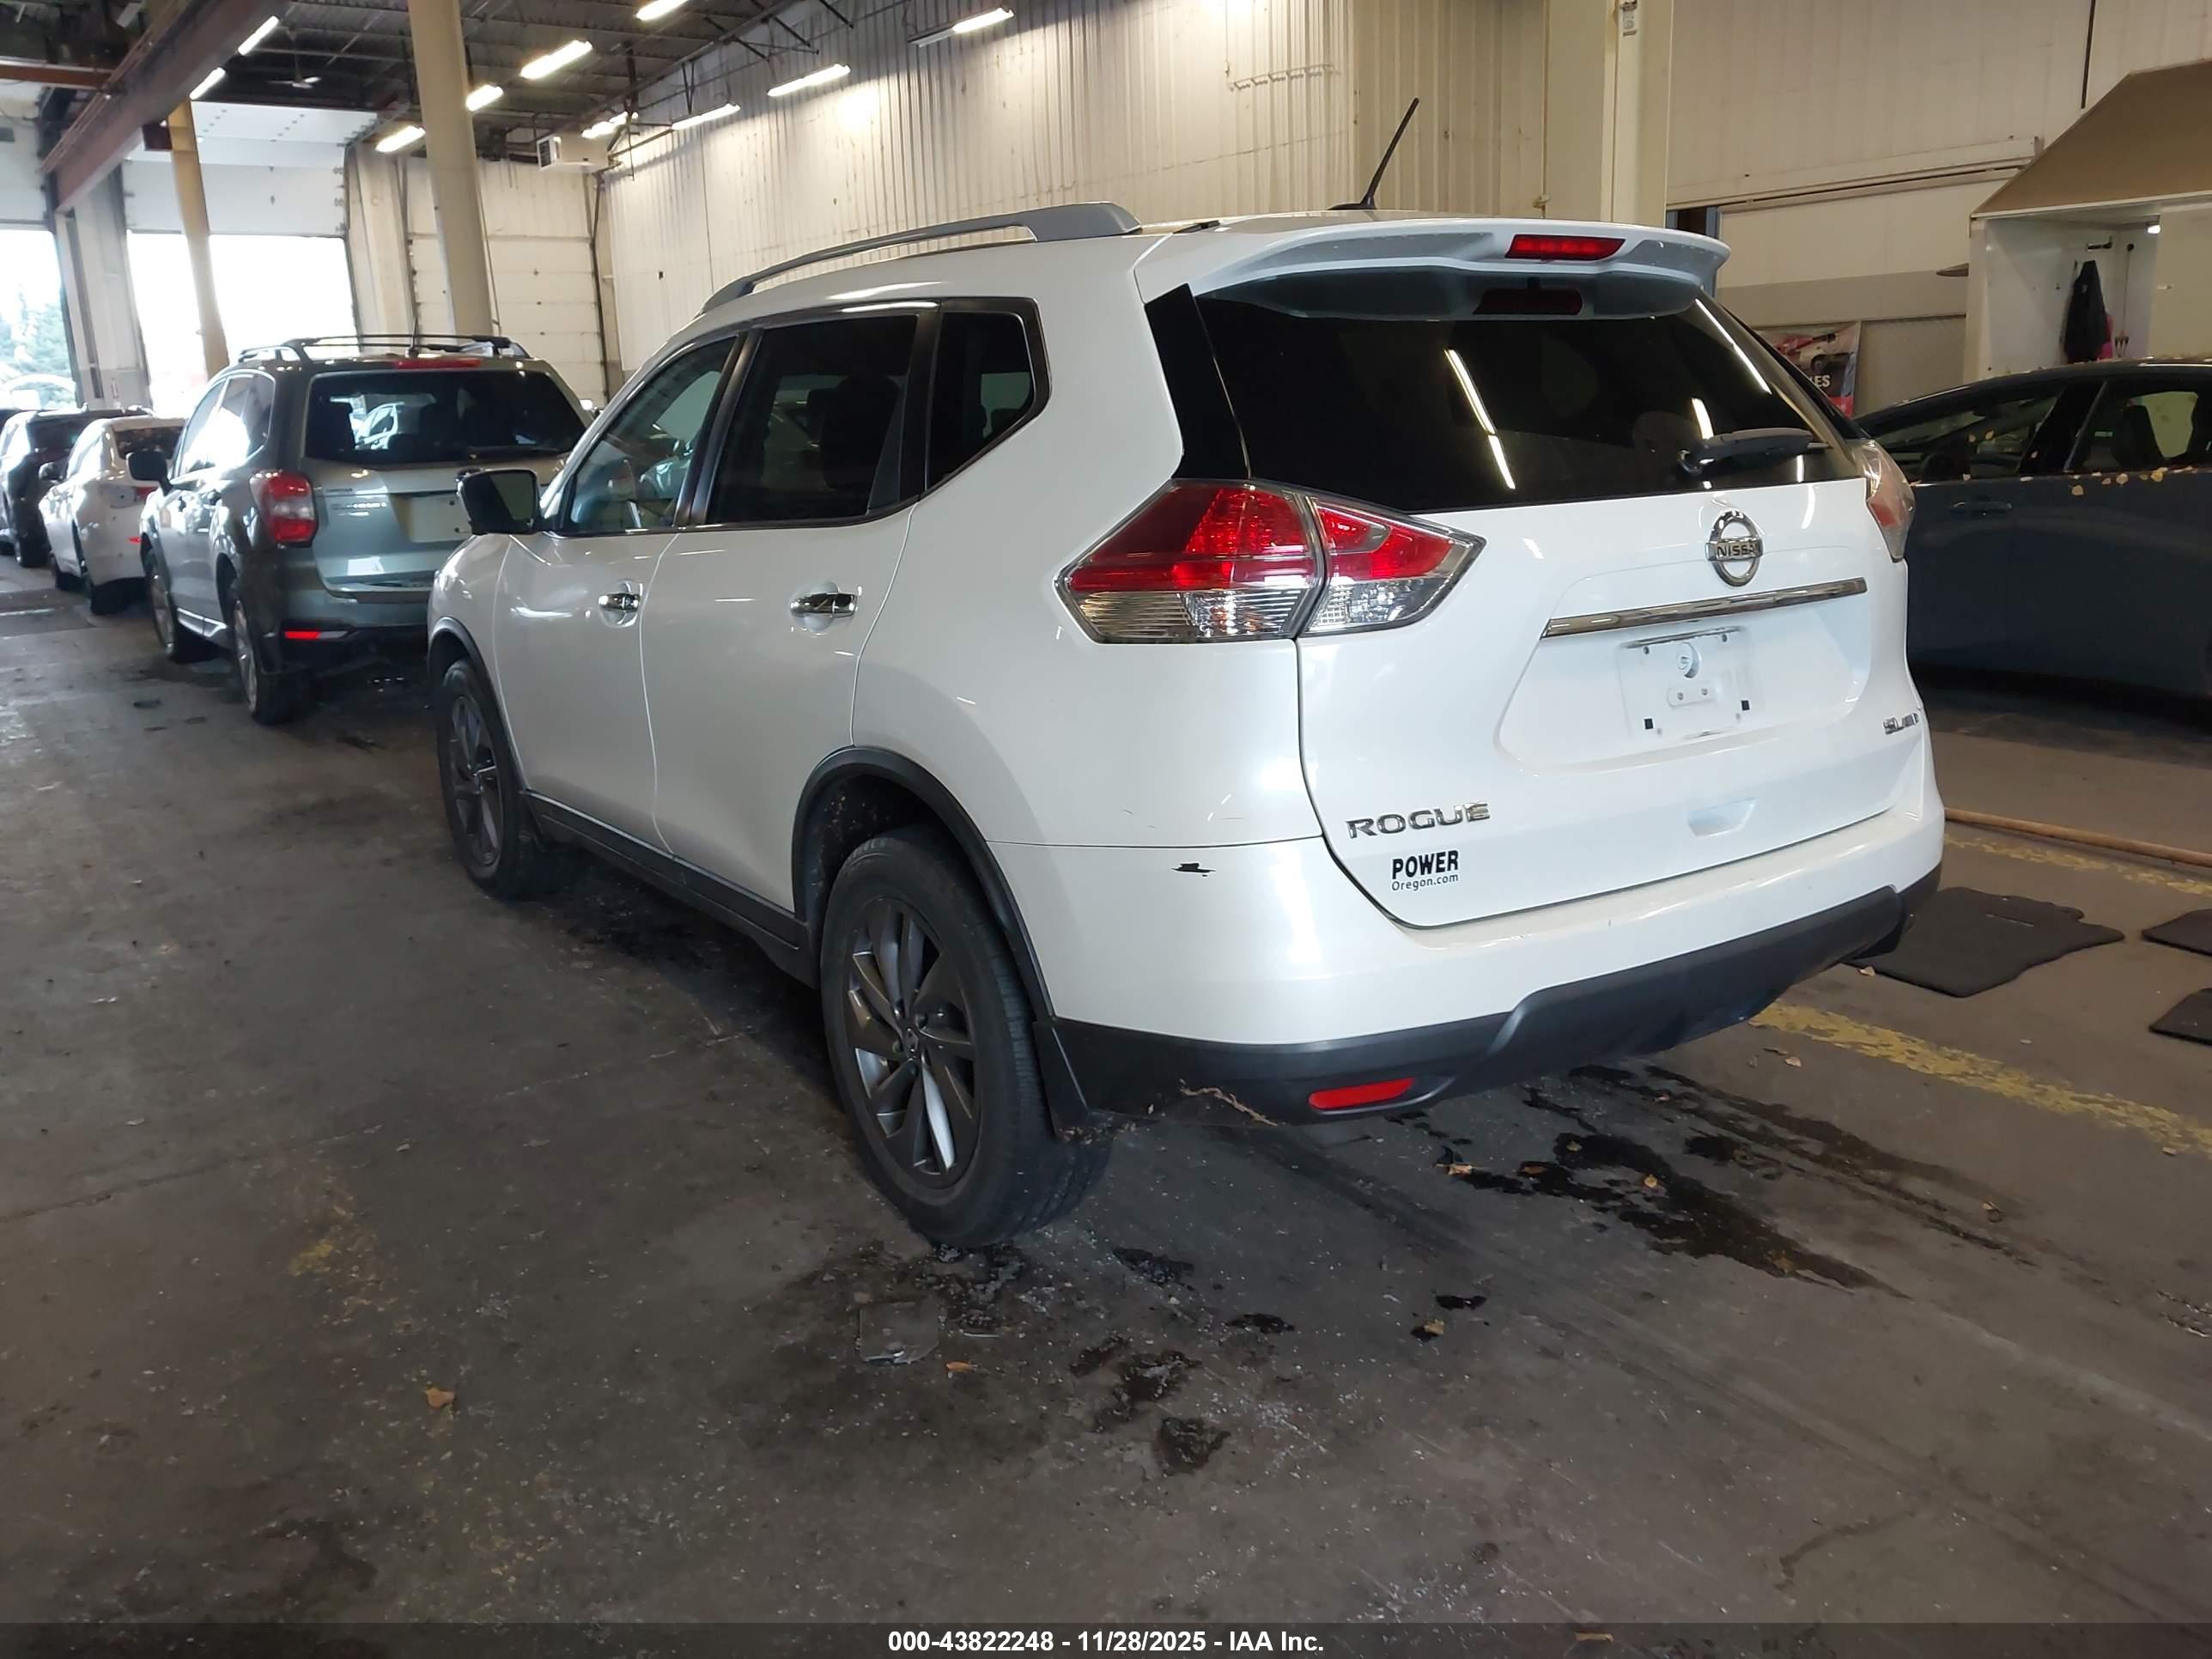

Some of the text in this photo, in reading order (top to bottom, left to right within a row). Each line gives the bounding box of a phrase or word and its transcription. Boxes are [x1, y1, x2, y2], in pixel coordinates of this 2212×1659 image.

[1345, 802, 1491, 839] ROGUE
[1392, 850, 1459, 879] POWER
[1391, 873, 1459, 891] Oregon.com
